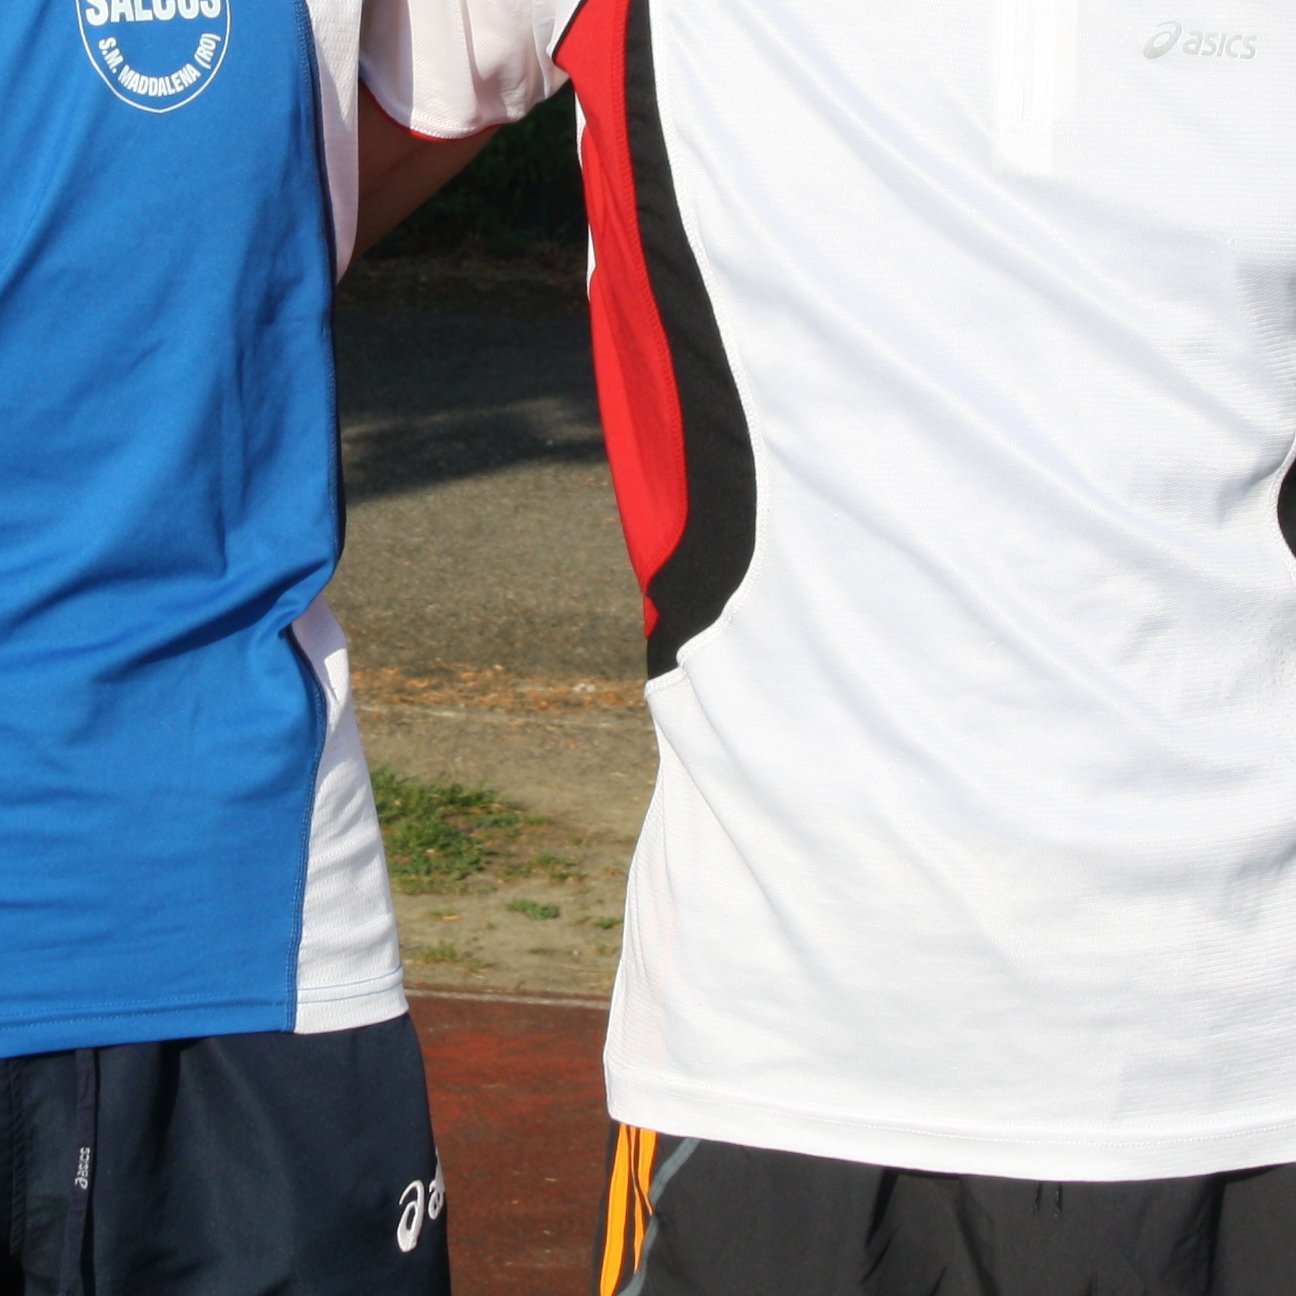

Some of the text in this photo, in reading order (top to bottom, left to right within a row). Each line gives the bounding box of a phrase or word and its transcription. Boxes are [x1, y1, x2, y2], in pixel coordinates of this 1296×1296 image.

[98, 33, 222, 97] S.M. MADDALENA (RO)
[1182, 30, 1258, 59] asics
